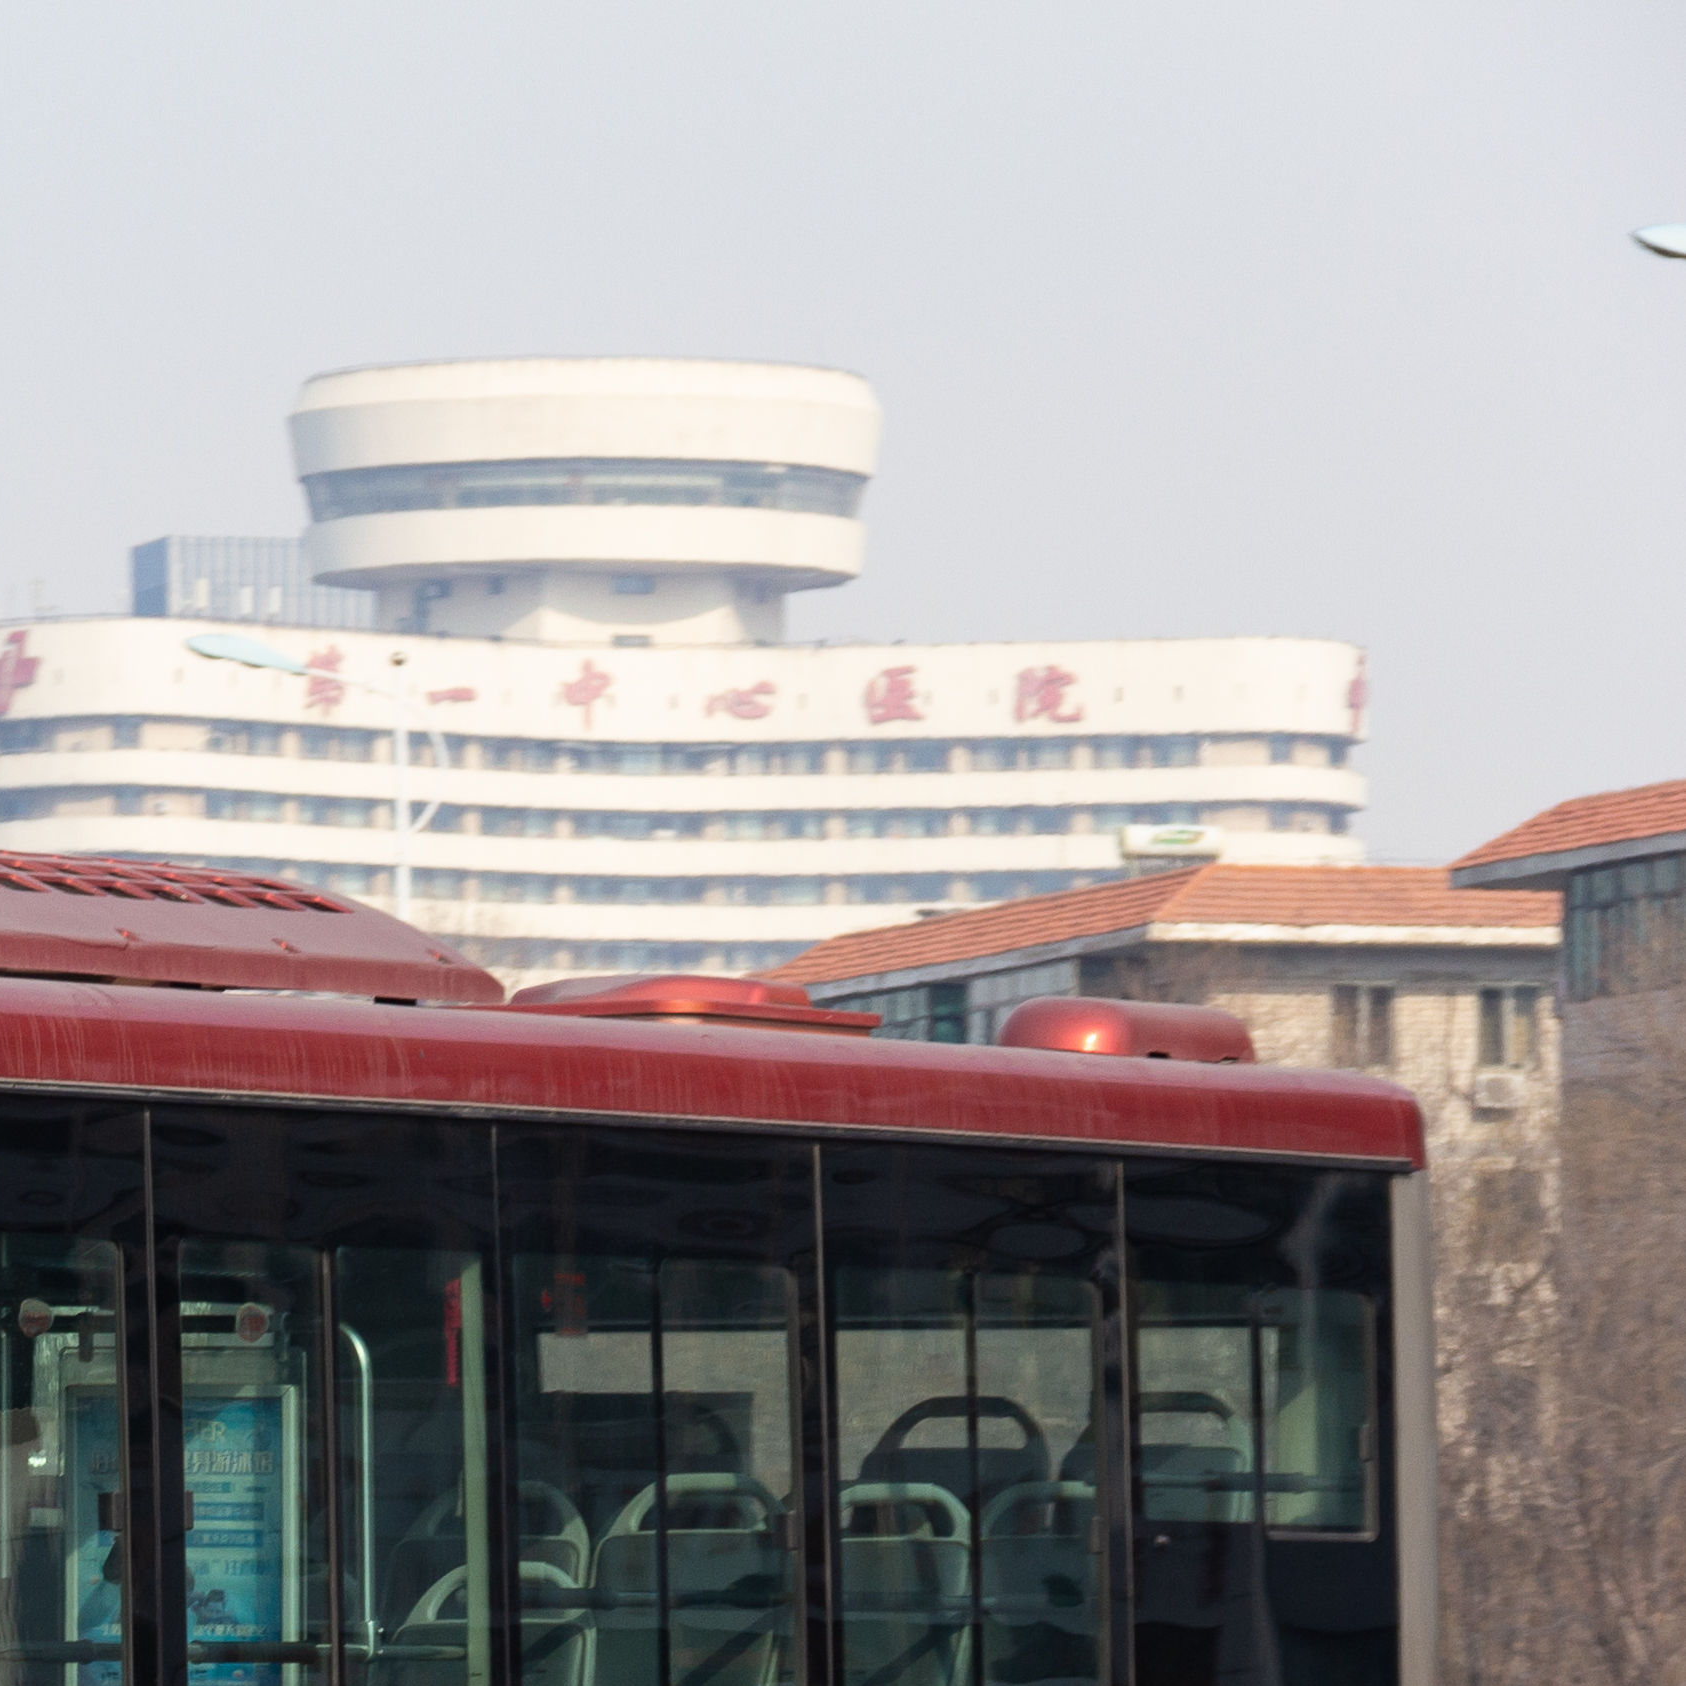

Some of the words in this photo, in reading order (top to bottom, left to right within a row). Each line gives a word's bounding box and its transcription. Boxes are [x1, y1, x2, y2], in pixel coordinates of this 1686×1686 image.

[303, 643, 1086, 729] 第一中心医院
